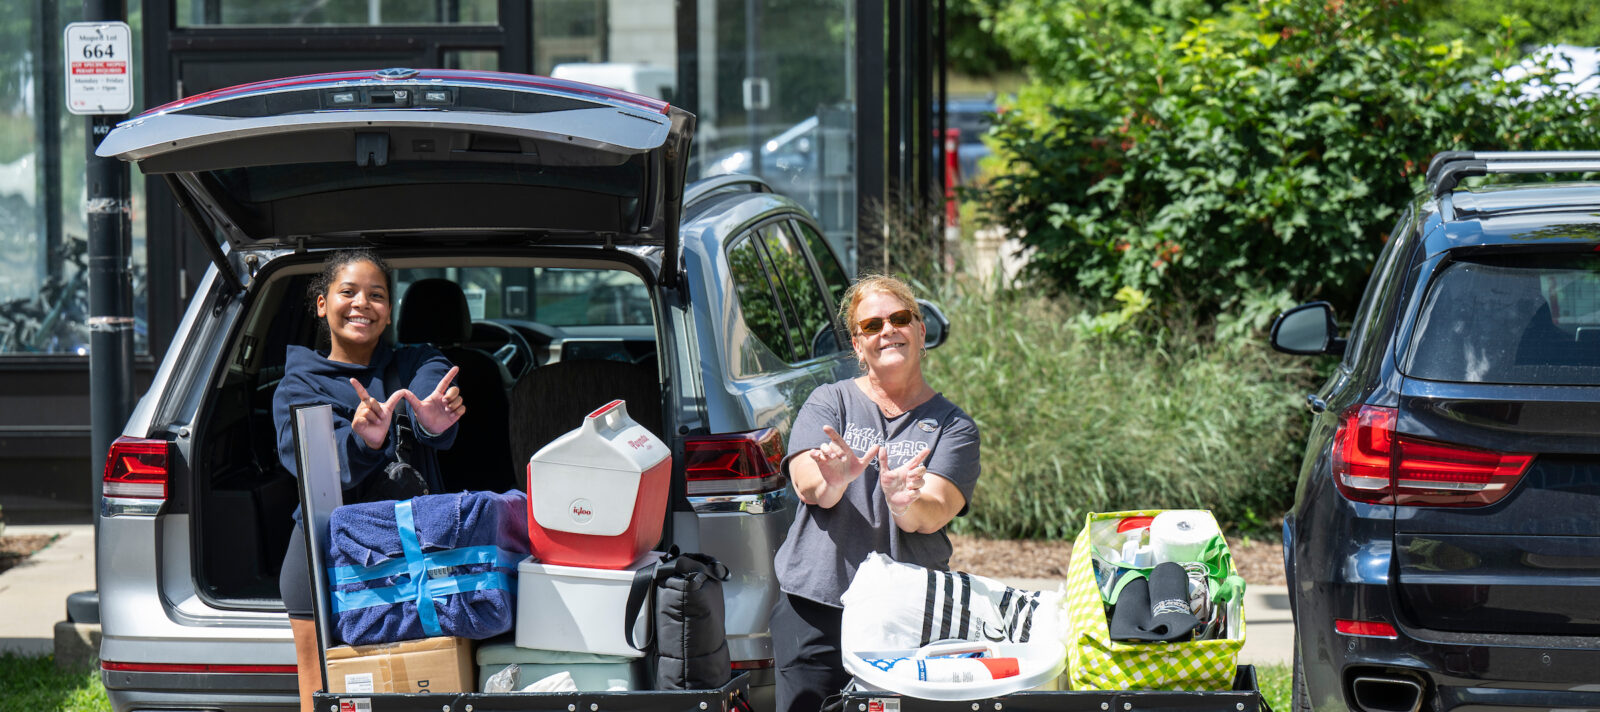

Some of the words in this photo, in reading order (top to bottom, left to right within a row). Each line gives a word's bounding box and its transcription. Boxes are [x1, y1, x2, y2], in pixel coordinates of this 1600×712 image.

[83, 44, 114, 59] 664
[93, 125, 110, 135] K47
[573, 506, 591, 516] igloo
